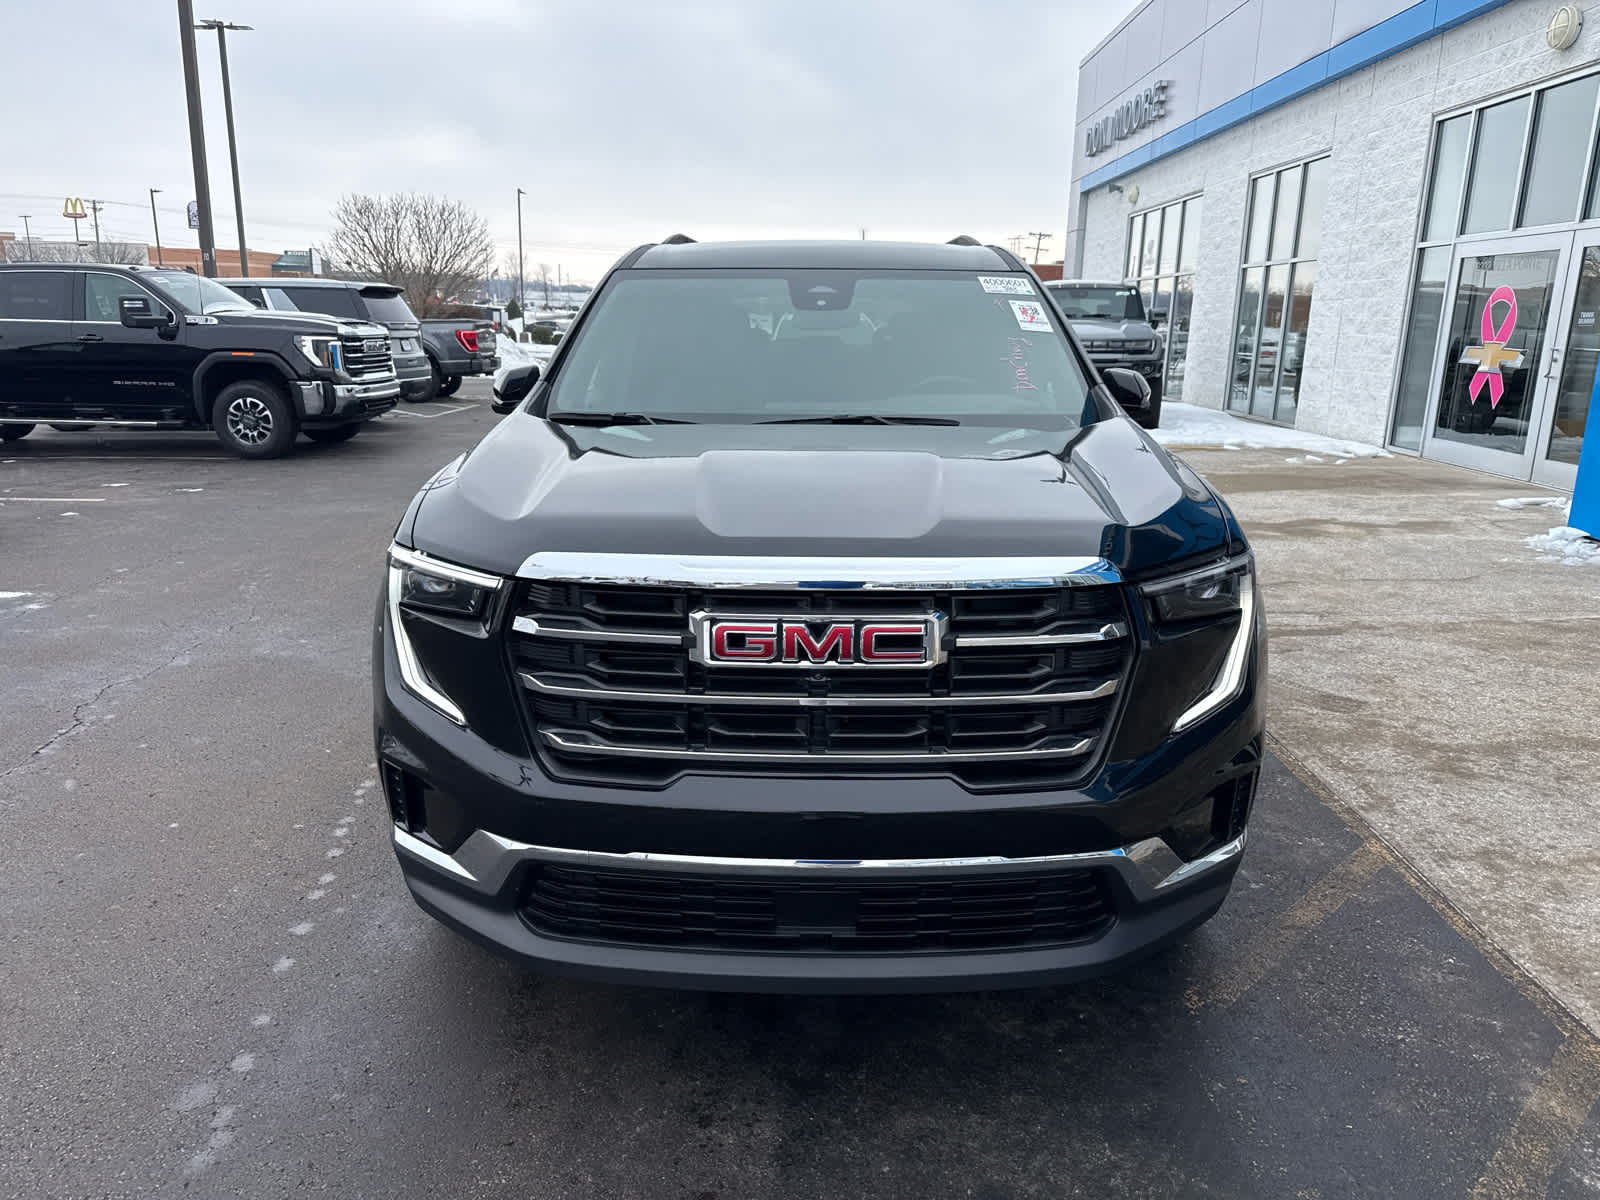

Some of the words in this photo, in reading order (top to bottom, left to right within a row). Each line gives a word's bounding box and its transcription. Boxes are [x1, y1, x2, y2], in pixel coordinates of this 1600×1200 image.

[1086, 116, 1113, 157] DON
[1113, 79, 1169, 140] MOORE
[712, 622, 927, 663] GMC
